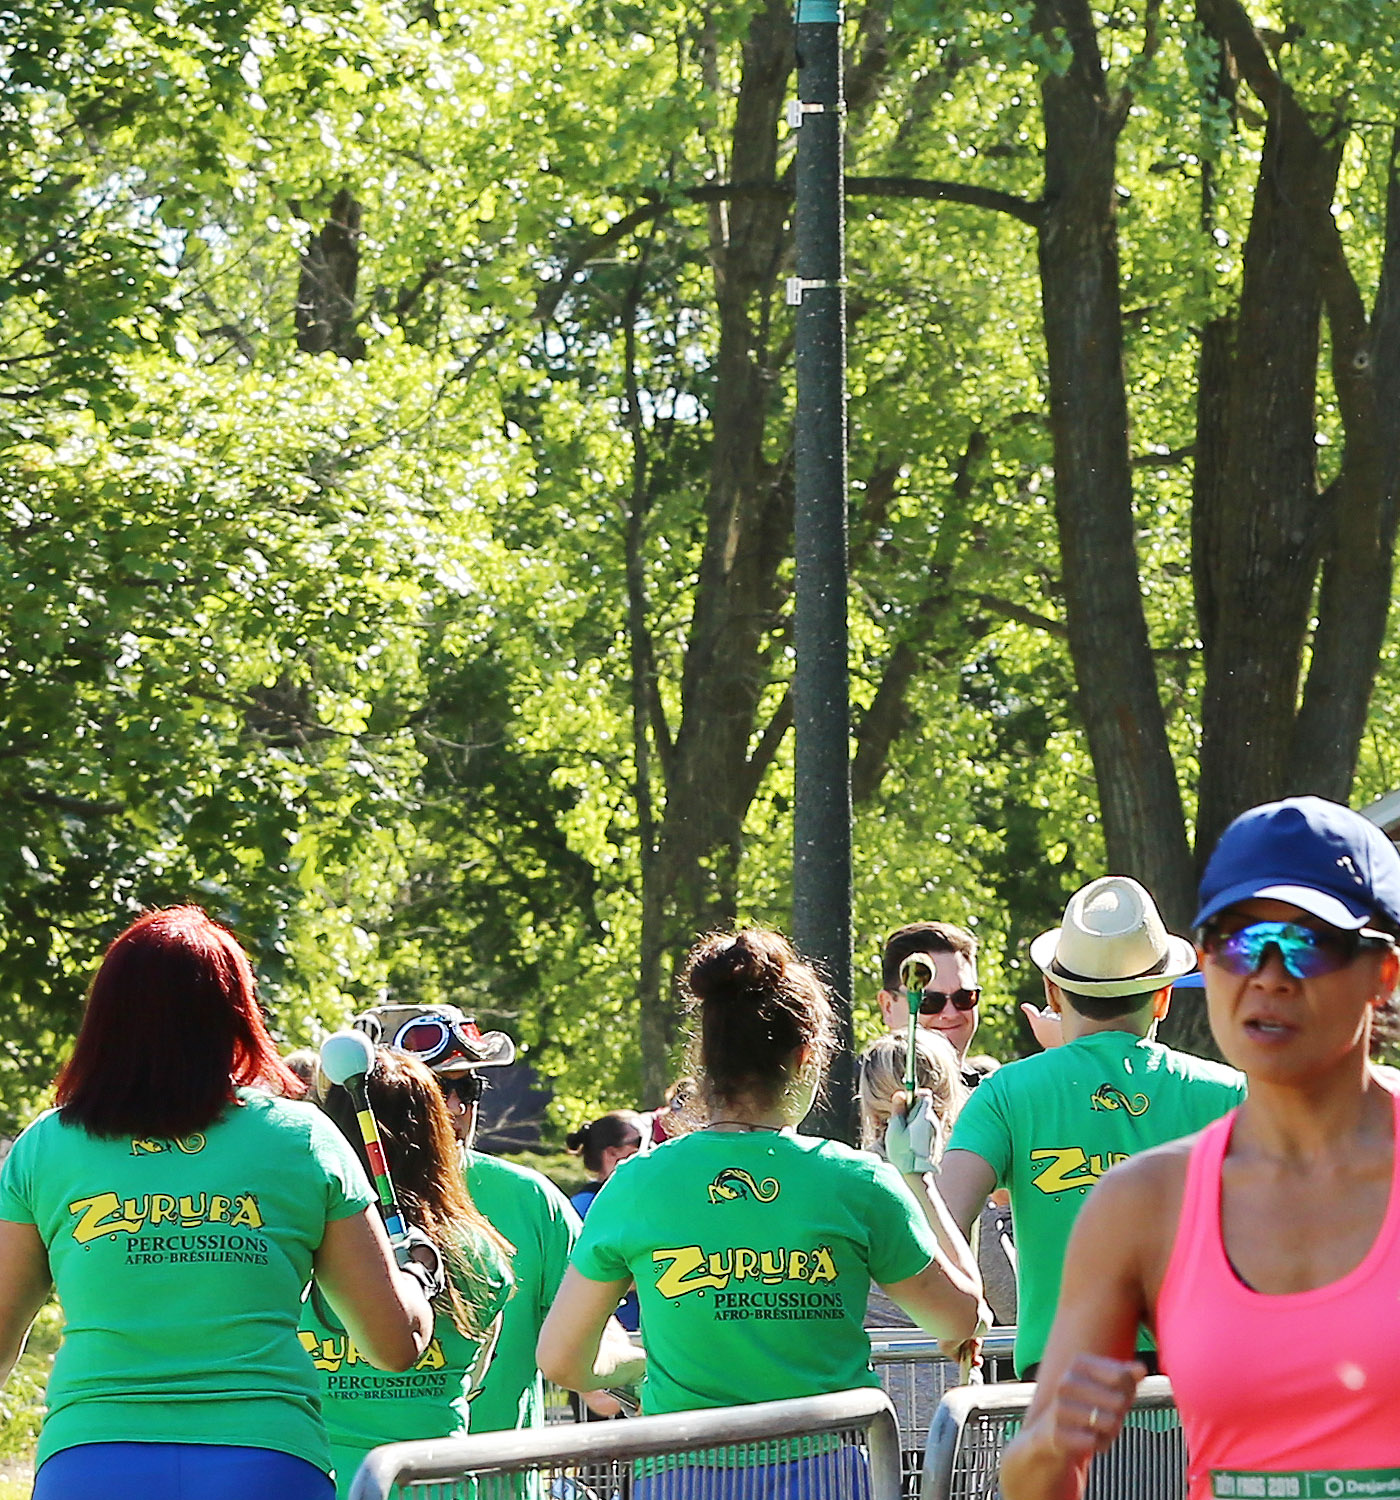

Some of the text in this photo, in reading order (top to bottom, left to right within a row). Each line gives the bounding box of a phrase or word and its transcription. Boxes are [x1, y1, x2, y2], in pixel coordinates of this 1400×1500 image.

[68, 1191, 265, 1245] ZURUBA
[126, 1234, 268, 1253] PERCUSSIONS
[124, 1250, 269, 1266] AFRO-BRÉSILIENNES
[652, 1244, 839, 1299] ZURUBA
[714, 1292, 843, 1309] PERCUSSIONS
[714, 1308, 845, 1321] AFRO-BRÉSILIENNES
[328, 1373, 447, 1389] PERCUSSIONS
